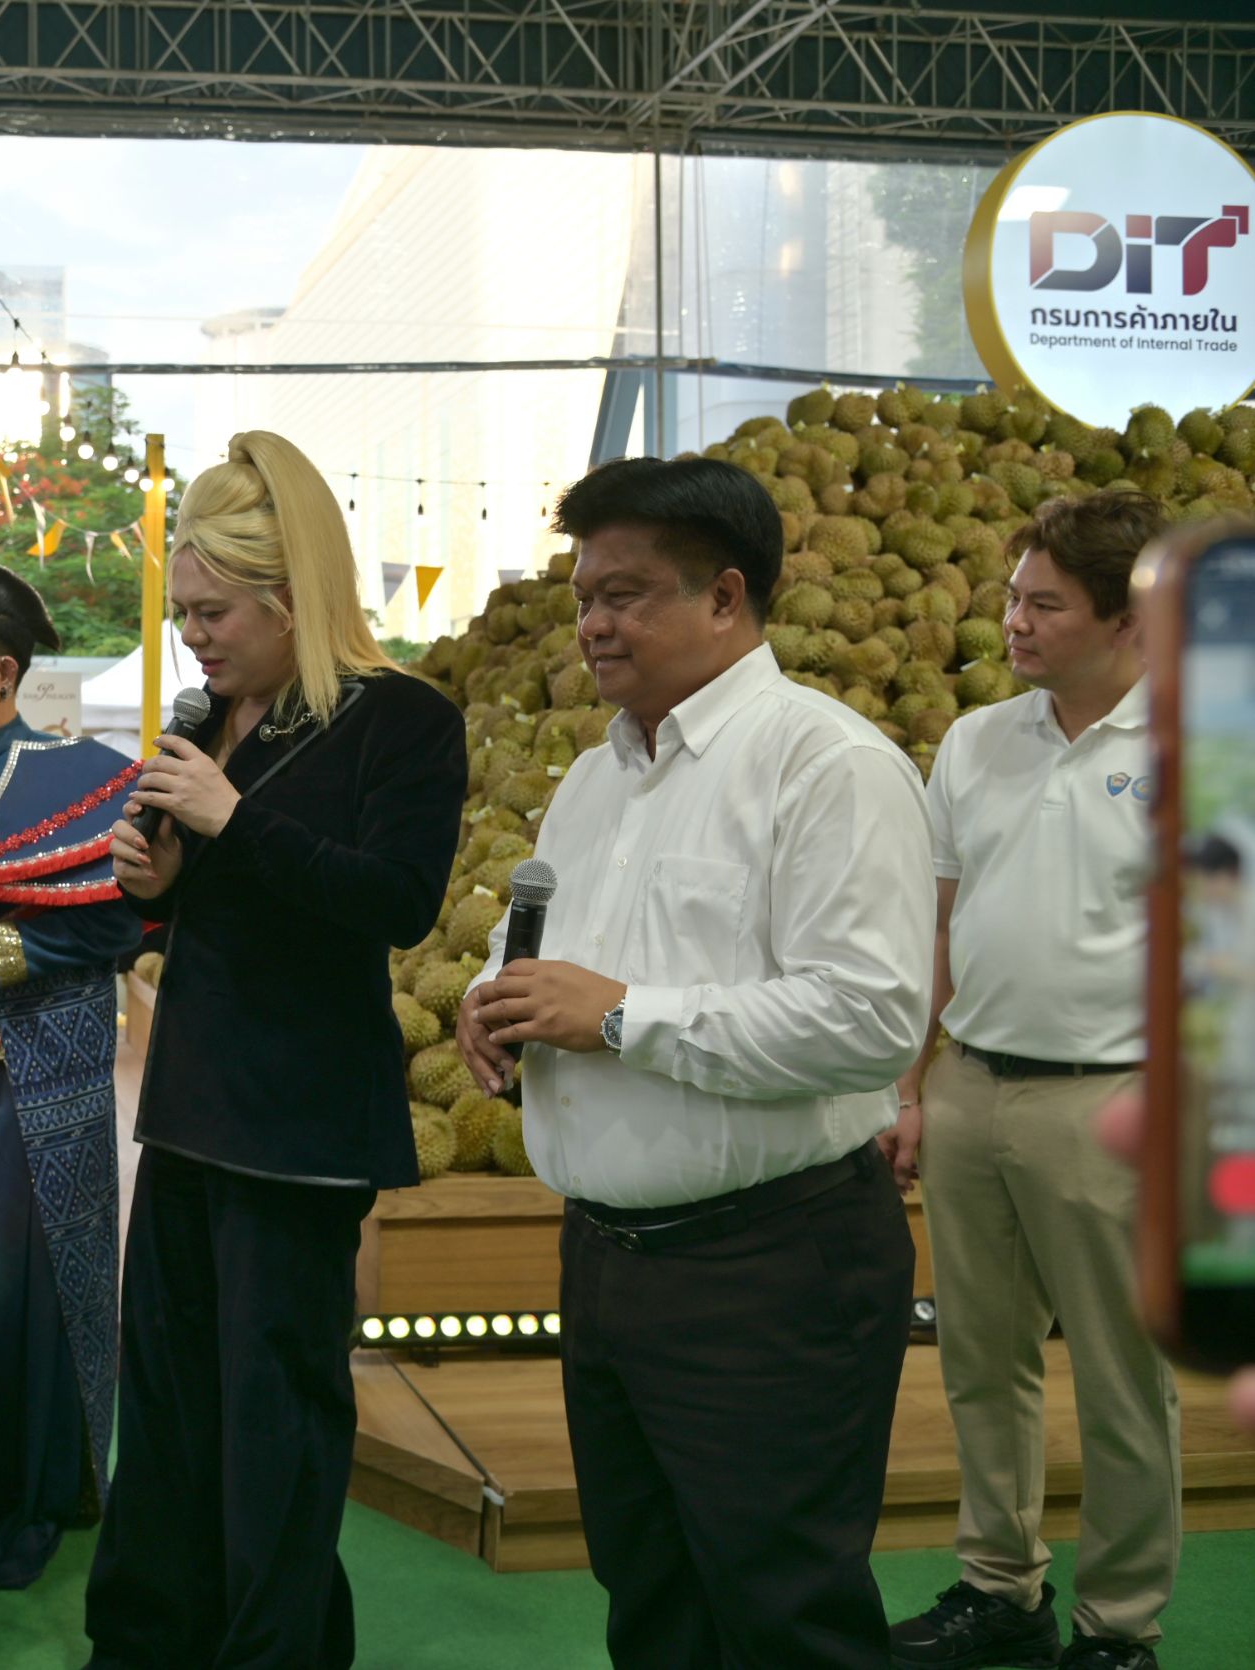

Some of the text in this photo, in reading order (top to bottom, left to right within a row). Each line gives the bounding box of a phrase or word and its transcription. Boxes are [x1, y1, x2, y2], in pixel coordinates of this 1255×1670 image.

[1031, 304, 1237, 332] กรมการค้าภายใน
[1030, 332, 1238, 352] Department of Internal Trade
